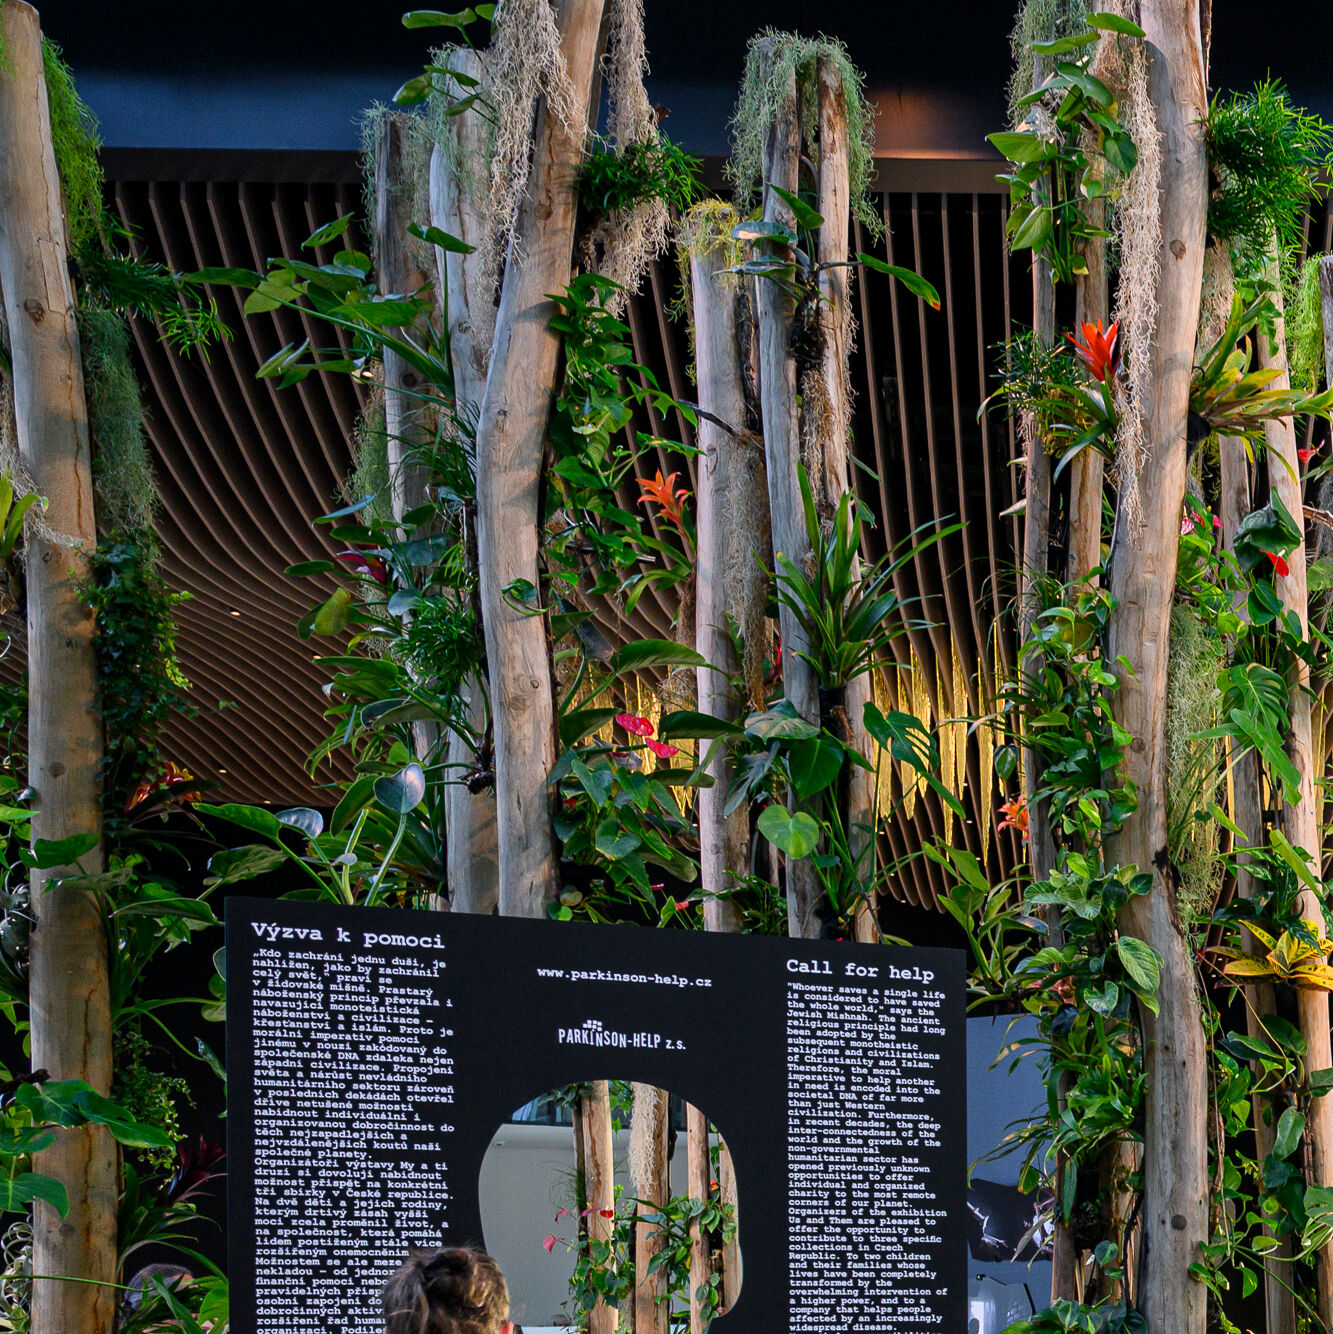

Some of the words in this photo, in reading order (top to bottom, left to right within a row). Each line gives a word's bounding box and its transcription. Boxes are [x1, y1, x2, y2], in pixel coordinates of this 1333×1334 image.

[251, 922, 324, 945] Výzva
[336, 927, 351, 943] k
[363, 932, 445, 949] pomoci
[536, 968, 712, 988] www.parkinson-help.cz
[786, 959, 833, 975] Call
[845, 962, 879, 978] for
[889, 965, 935, 985] help
[787, 981, 834, 993] "Whoever
[838, 986, 867, 994] saves
[883, 987, 918, 999] single
[922, 990, 945, 999] life
[787, 1017, 839, 1030] religious
[844, 1020, 896, 1033] principle
[900, 1024, 918, 1032] had
[922, 1025, 945, 1035] long
[558, 1028, 661, 1049] PARKINSON-HELP
[337, 1051, 359, 1060] DNA
[365, 1052, 413, 1063] zdaleka
[419, 1055, 454, 1066] nejen
[352, 1081, 400, 1091] sektoru
[787, 1125, 896, 1137] inter-connectedness
[901, 1129, 913, 1137] of
[918, 1129, 935, 1138] the
[788, 1206, 846, 1217] Organizers
[851, 1207, 863, 1215] of
[890, 1208, 947, 1216] exhibition
